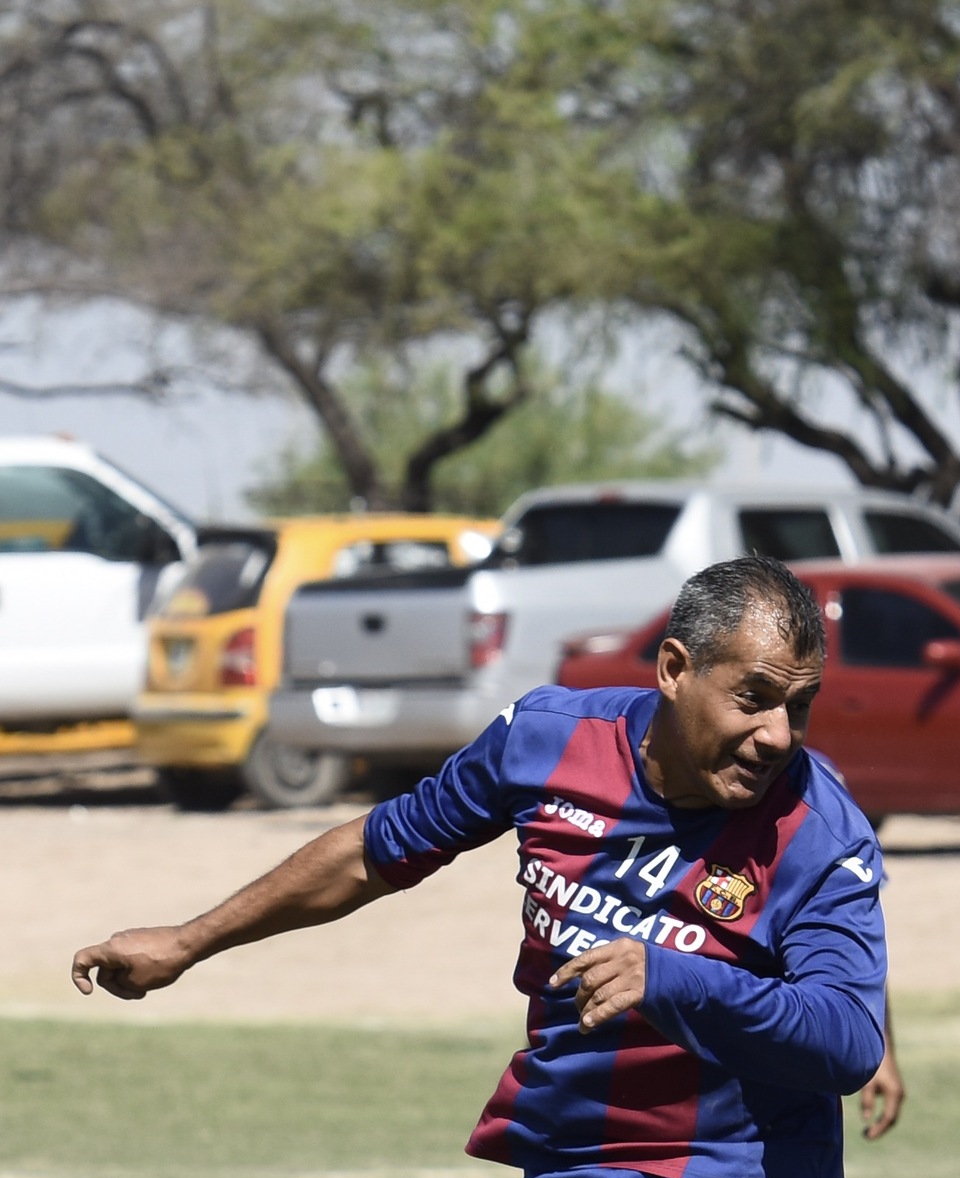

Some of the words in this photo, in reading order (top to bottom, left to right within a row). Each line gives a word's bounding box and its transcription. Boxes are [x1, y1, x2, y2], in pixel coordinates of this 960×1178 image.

[544, 795, 606, 838] Joma
[614, 835, 681, 898] 14
[523, 857, 706, 953] SINDICATO
